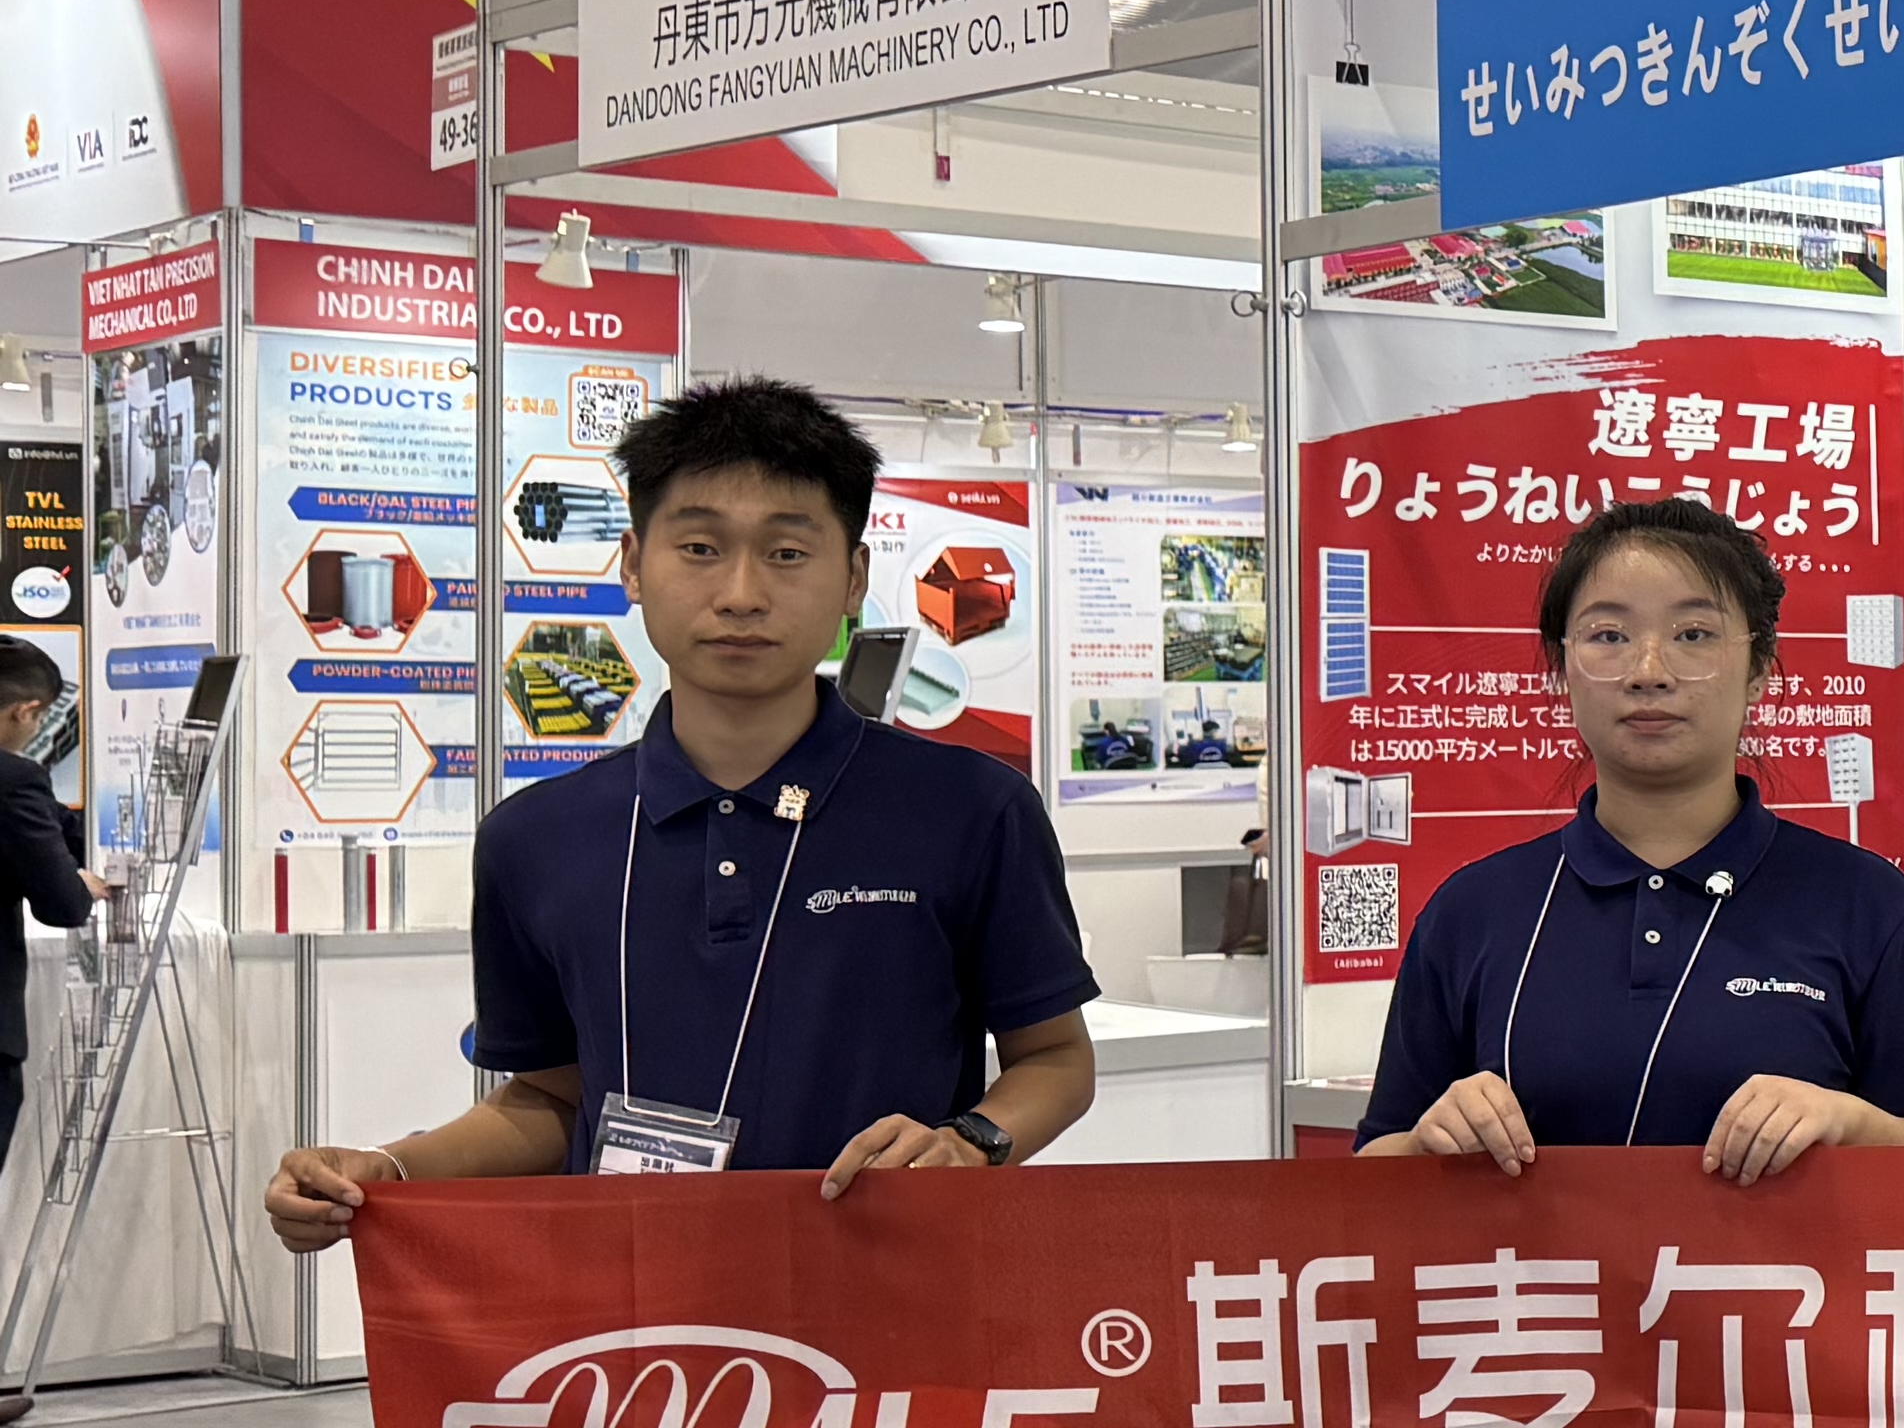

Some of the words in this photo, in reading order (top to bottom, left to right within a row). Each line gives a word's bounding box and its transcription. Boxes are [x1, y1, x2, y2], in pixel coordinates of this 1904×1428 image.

[606, 83, 701, 129] DANDONG
[708, 60, 821, 110] FANGYUAN
[828, 34, 959, 88] MACHINERY
[967, 19, 1014, 60] CO.,
[1023, 0, 1069, 44] LTD
[77, 129, 103, 162] VIA
[165, 252, 215, 289] PRECISION
[317, 254, 414, 290] CHINH
[423, 261, 474, 294] DAI
[88, 303, 154, 341] MECHANICAL
[177, 293, 198, 321] LTD
[317, 291, 478, 328] INDUSTRIA
[503, 303, 562, 339] CO.,
[569, 309, 622, 339] LTD
[290, 351, 467, 383] DIVERSIFIED
[290, 382, 451, 411] PRODUCTS
[1589, 389, 1856, 470] 遼寧工場
[25, 491, 65, 510] TVL
[6, 515, 84, 530] STAINLESS
[23, 536, 67, 550] STEEL
[557, 586, 587, 598] PIPE
